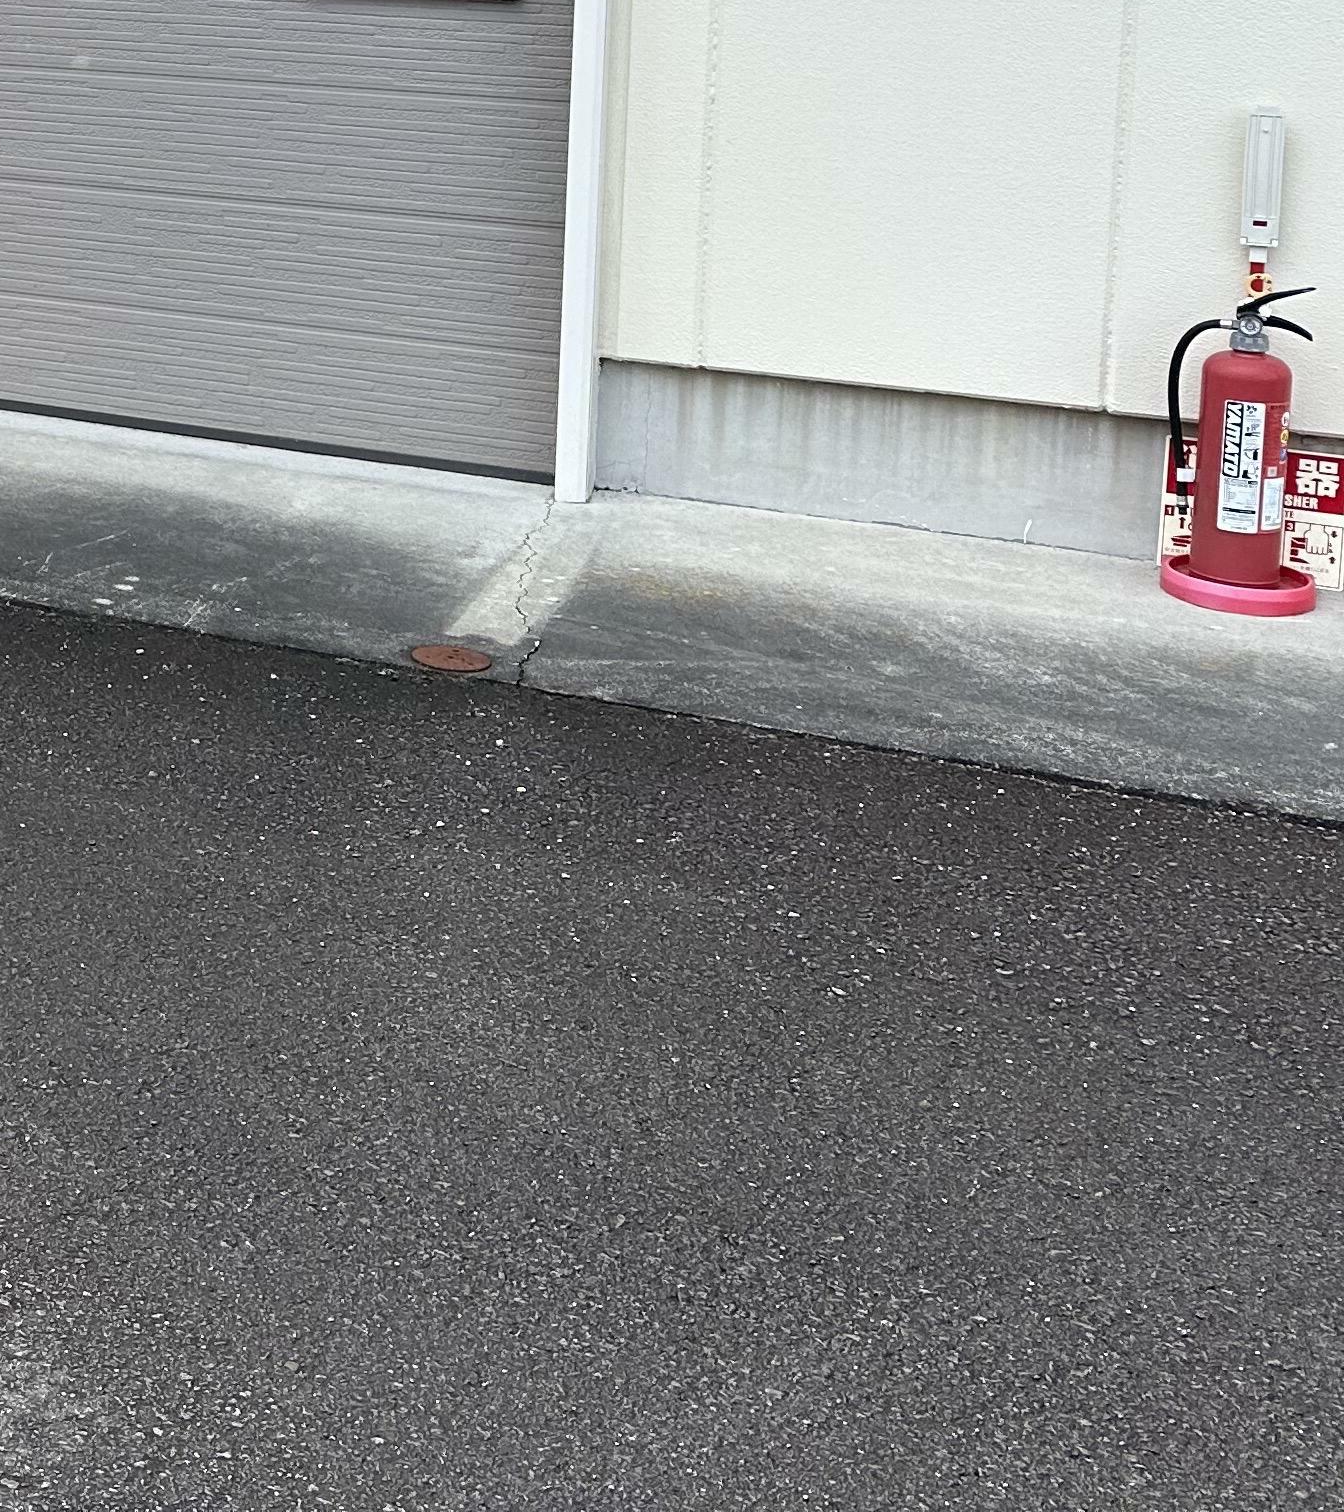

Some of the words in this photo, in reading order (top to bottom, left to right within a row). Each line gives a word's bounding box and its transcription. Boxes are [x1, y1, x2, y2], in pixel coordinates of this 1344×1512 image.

[1223, 402, 1243, 478] YAMATO
[1295, 458, 1340, 498] 器
[1284, 493, 1319, 510] SHER
